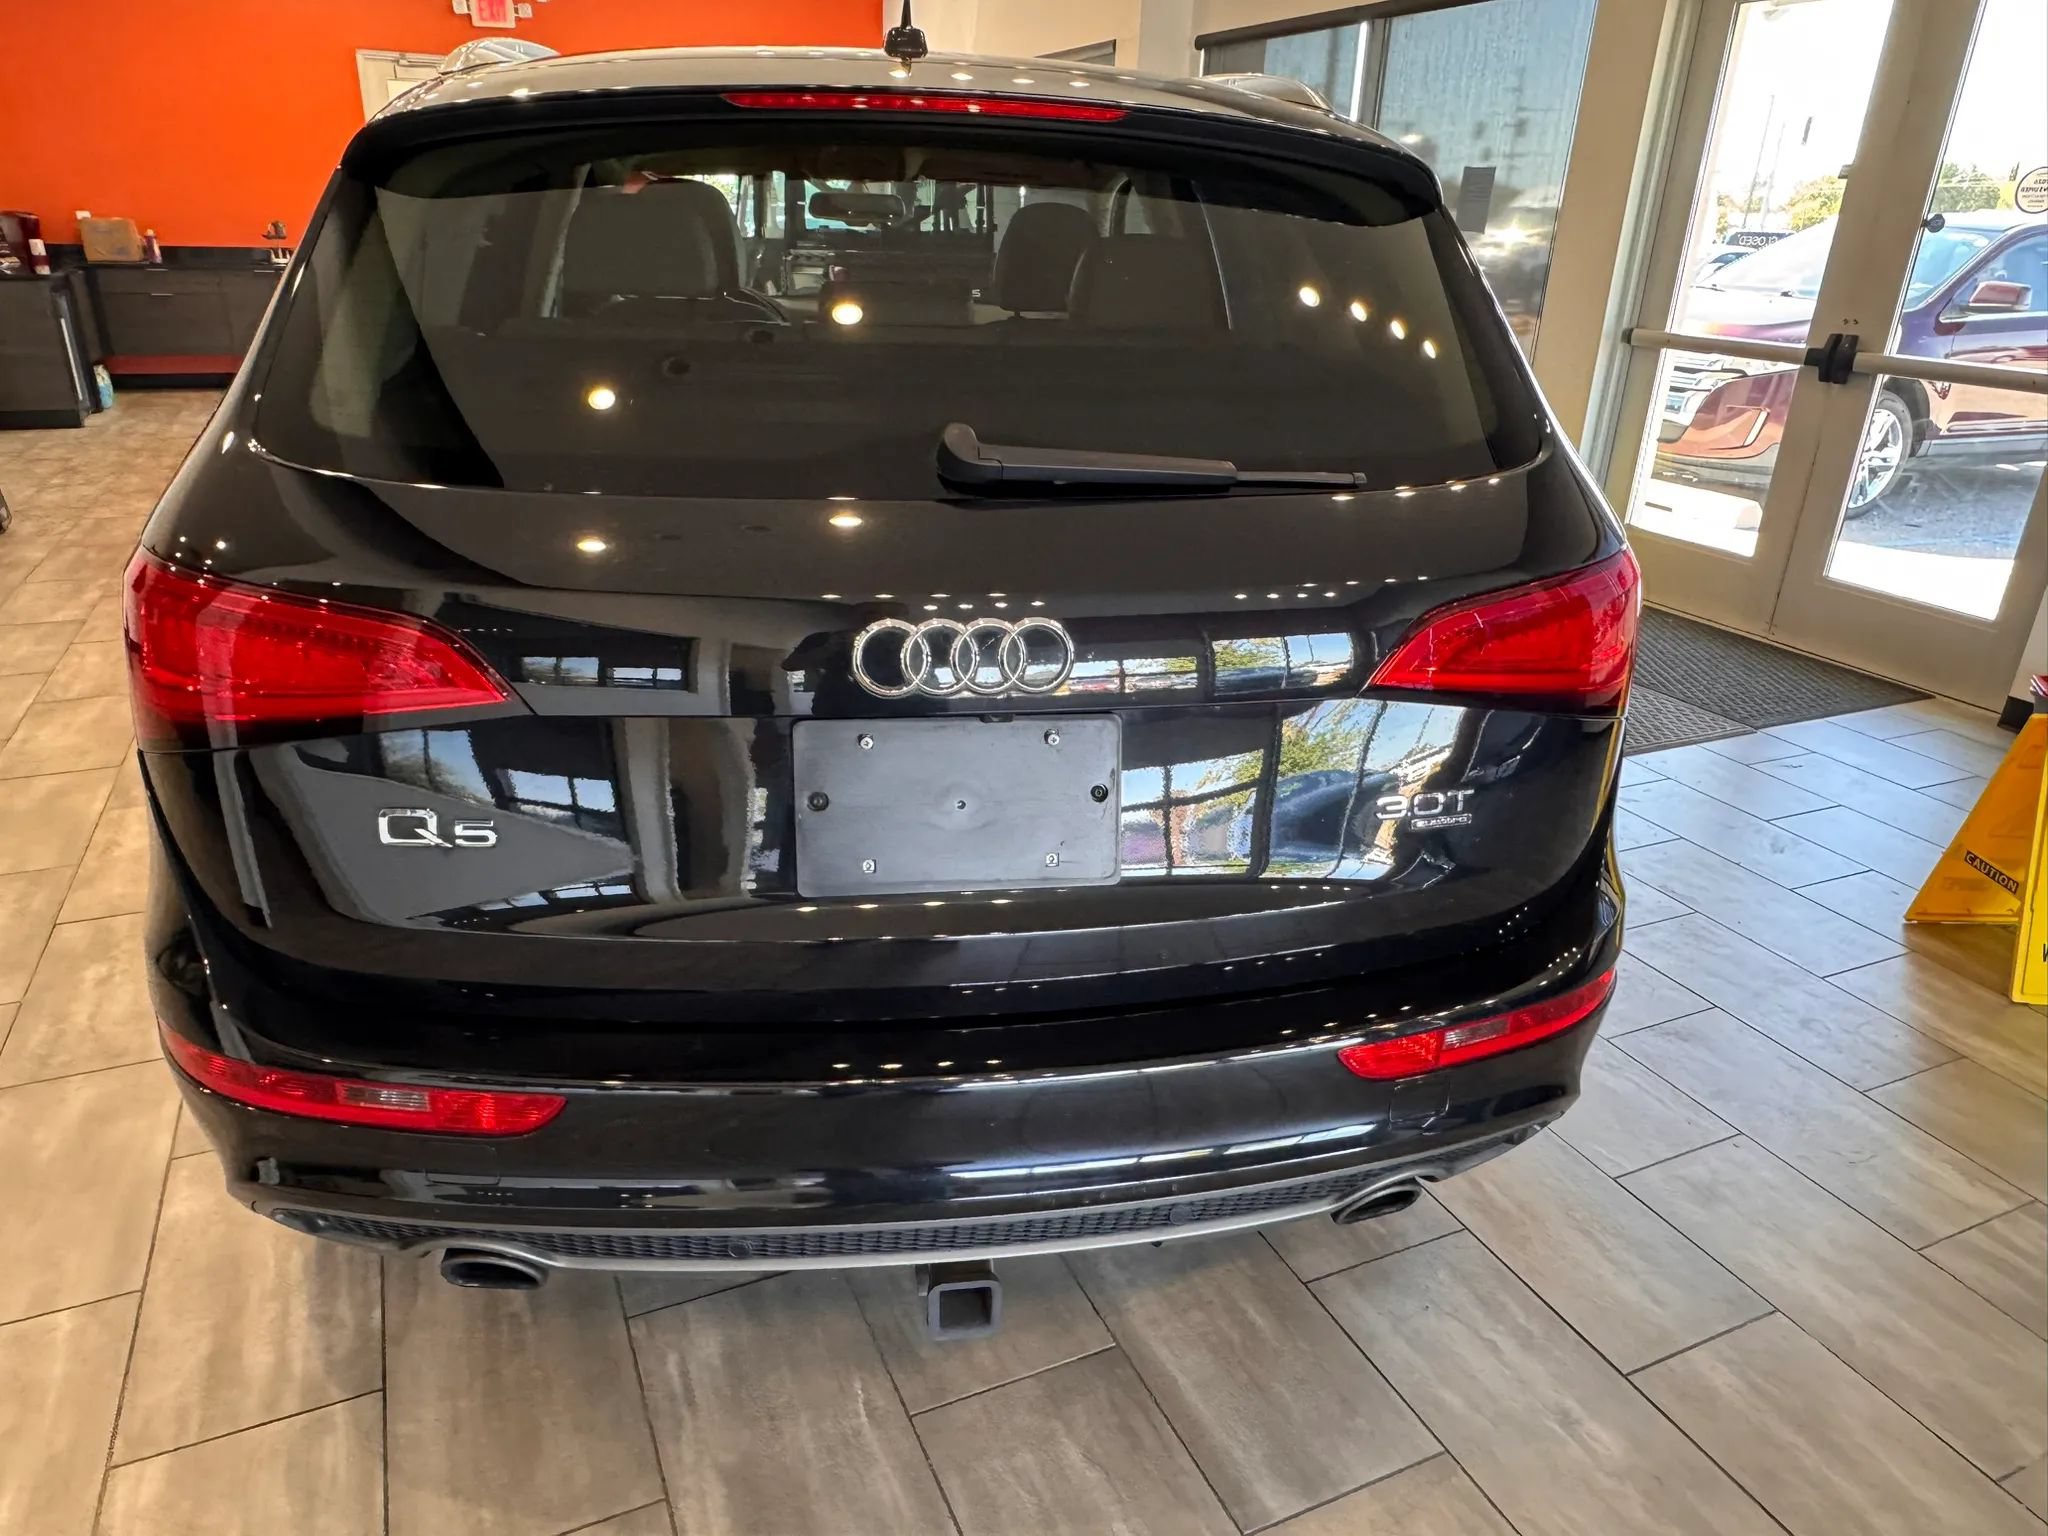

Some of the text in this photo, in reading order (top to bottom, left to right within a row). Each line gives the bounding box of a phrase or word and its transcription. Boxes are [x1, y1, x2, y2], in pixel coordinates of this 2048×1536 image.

[1376, 789, 1475, 819] 3.0T
[378, 808, 497, 848] Q5
[1966, 852, 2018, 892] CAUTION
